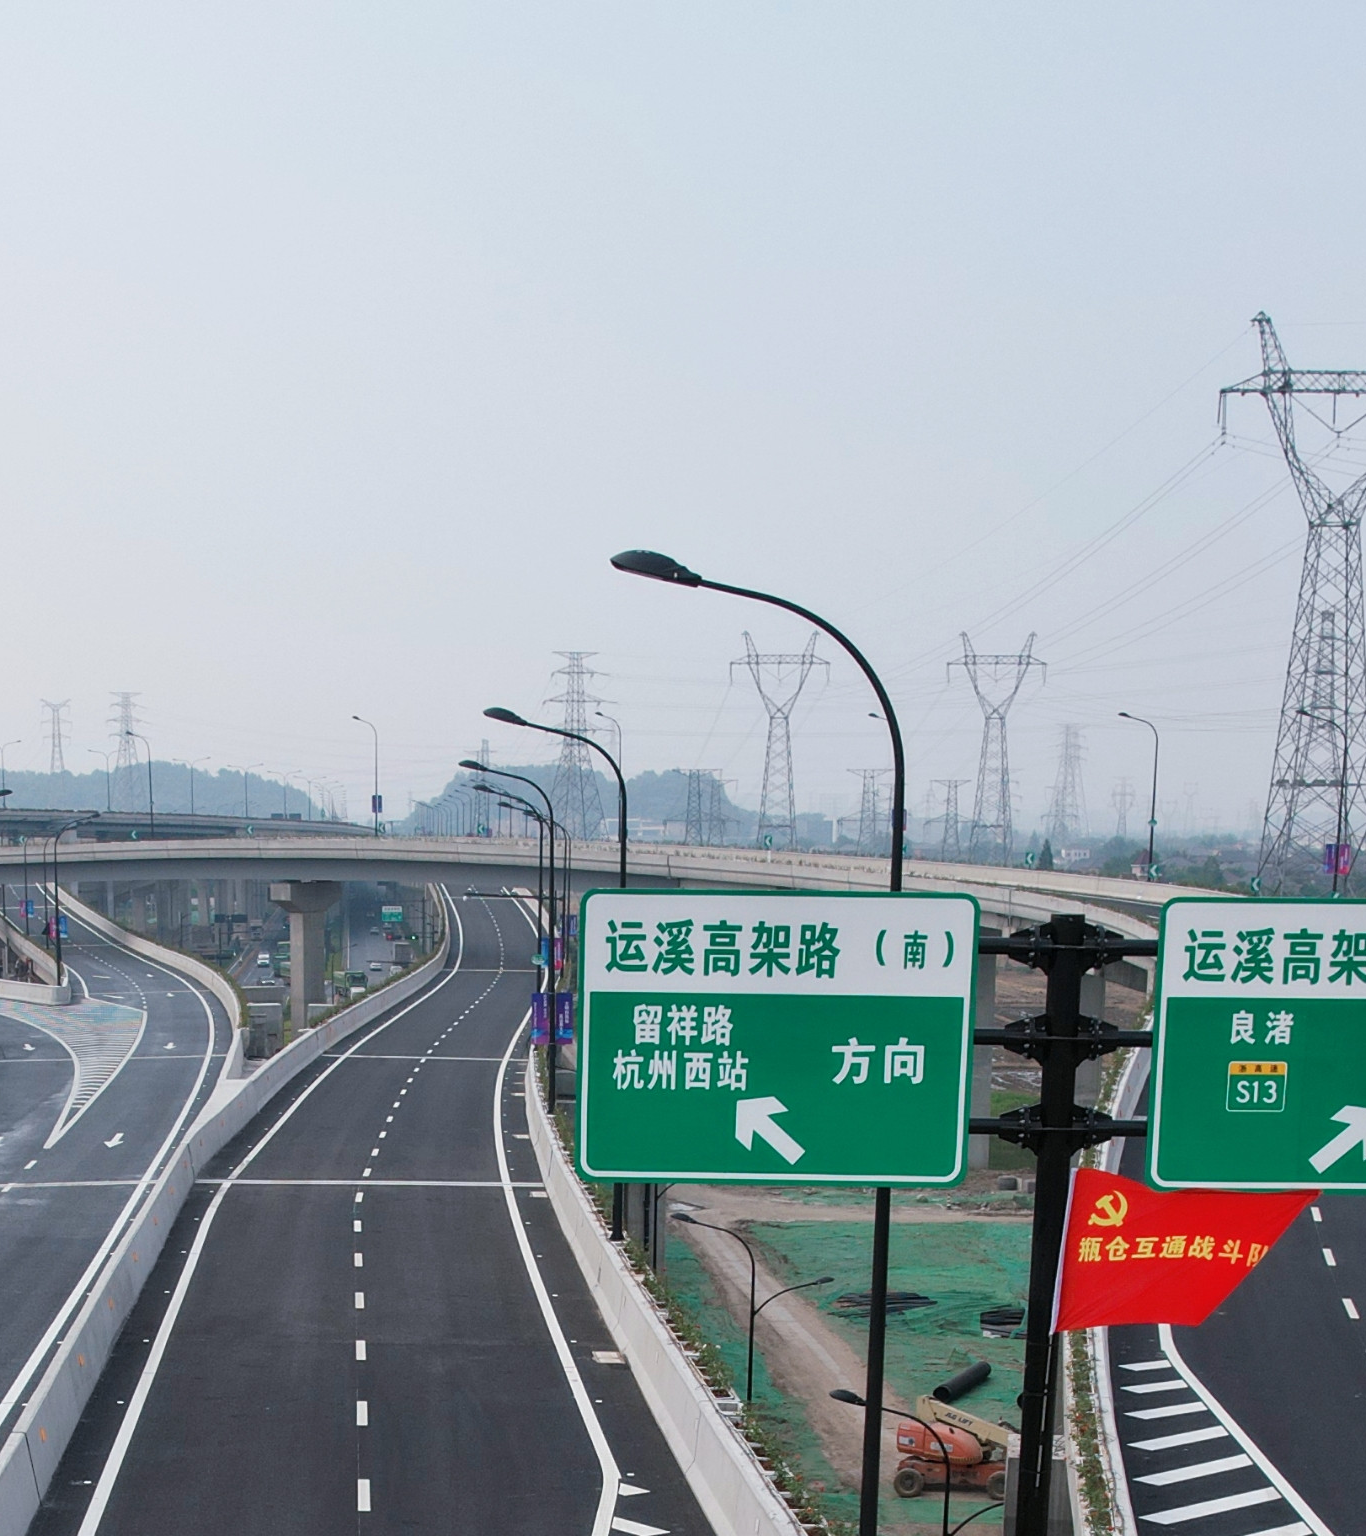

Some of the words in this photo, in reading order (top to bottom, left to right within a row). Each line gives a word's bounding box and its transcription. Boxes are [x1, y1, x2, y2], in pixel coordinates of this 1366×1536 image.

[633, 1004, 733, 1043] 留祥路
[1230, 1010, 1294, 1045] 良渚
[613, 1050, 749, 1091] 杭州西站
[831, 1037, 925, 1085] 方向
[1236, 1080, 1277, 1104] S13
